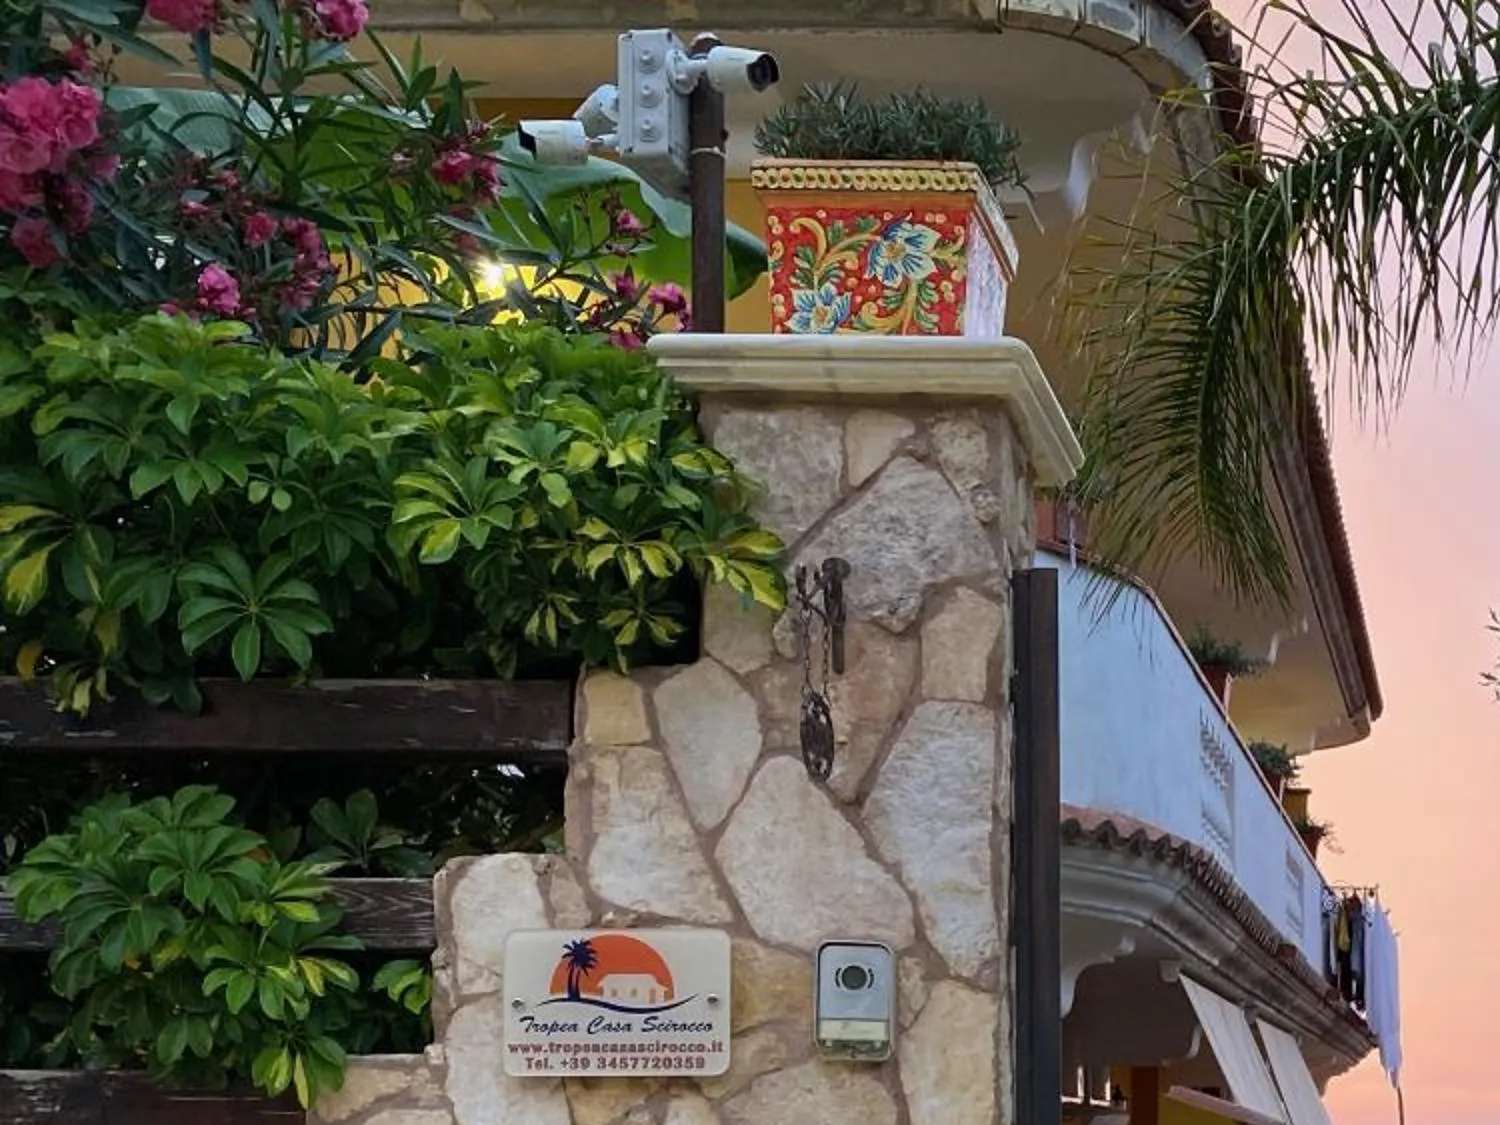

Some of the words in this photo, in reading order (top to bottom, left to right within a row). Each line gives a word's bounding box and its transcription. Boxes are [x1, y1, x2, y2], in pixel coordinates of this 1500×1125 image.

[519, 1016, 578, 1035] Tropea
[587, 1015, 632, 1034] Casa
[641, 1015, 713, 1032] Scirocco
[525, 1057, 554, 1070] Tel.
[560, 1057, 590, 1070] +39
